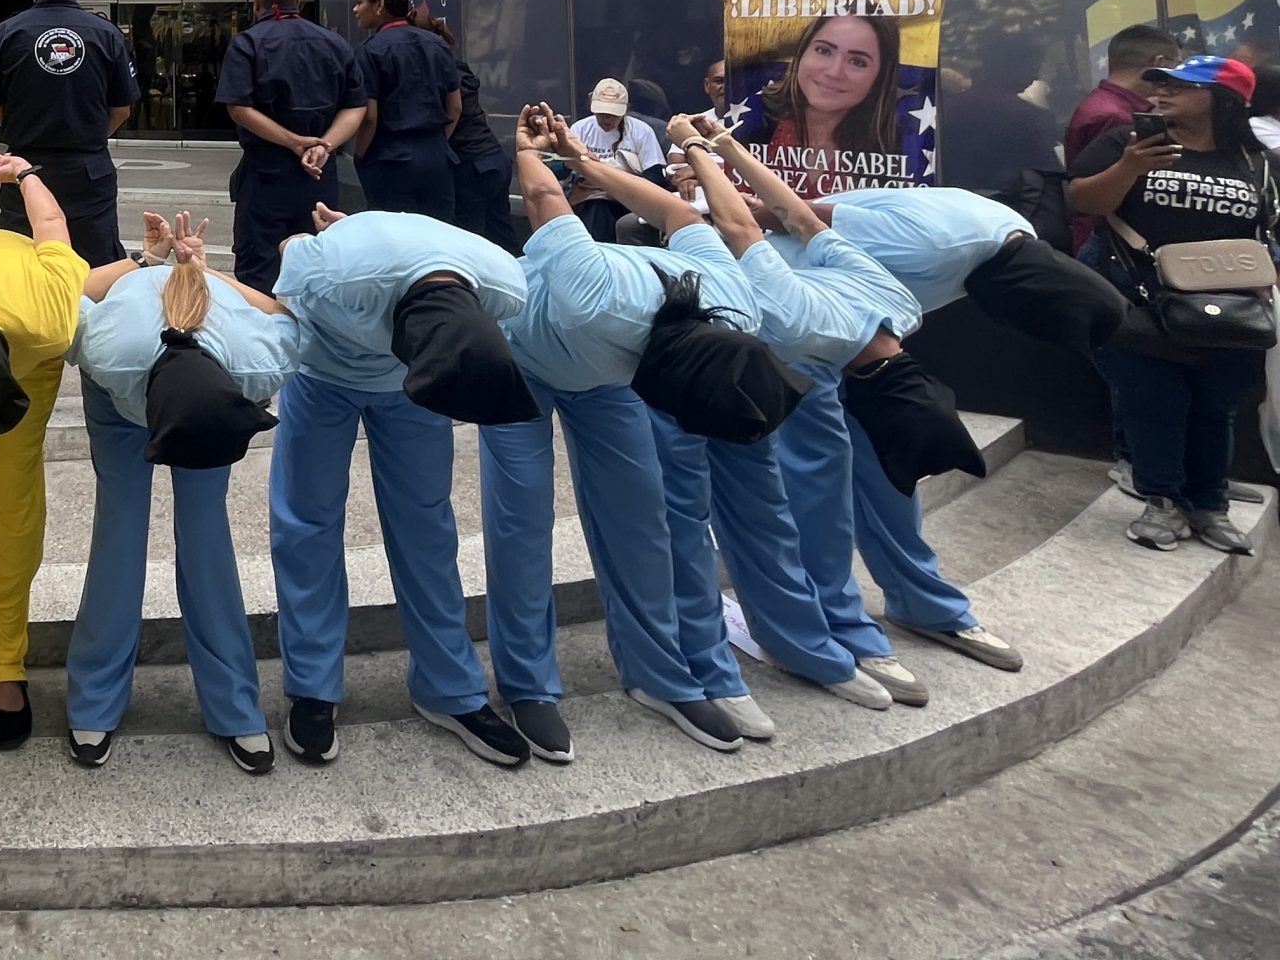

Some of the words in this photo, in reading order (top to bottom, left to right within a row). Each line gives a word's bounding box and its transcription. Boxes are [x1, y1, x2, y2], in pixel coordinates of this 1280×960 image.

[749, 143, 830, 171] BLANCA
[834, 149, 915, 179] ISABEL
[1146, 178, 1180, 192] LOS
[1186, 181, 1258, 204] PRESOS
[1180, 252, 1258, 275] TOUS
